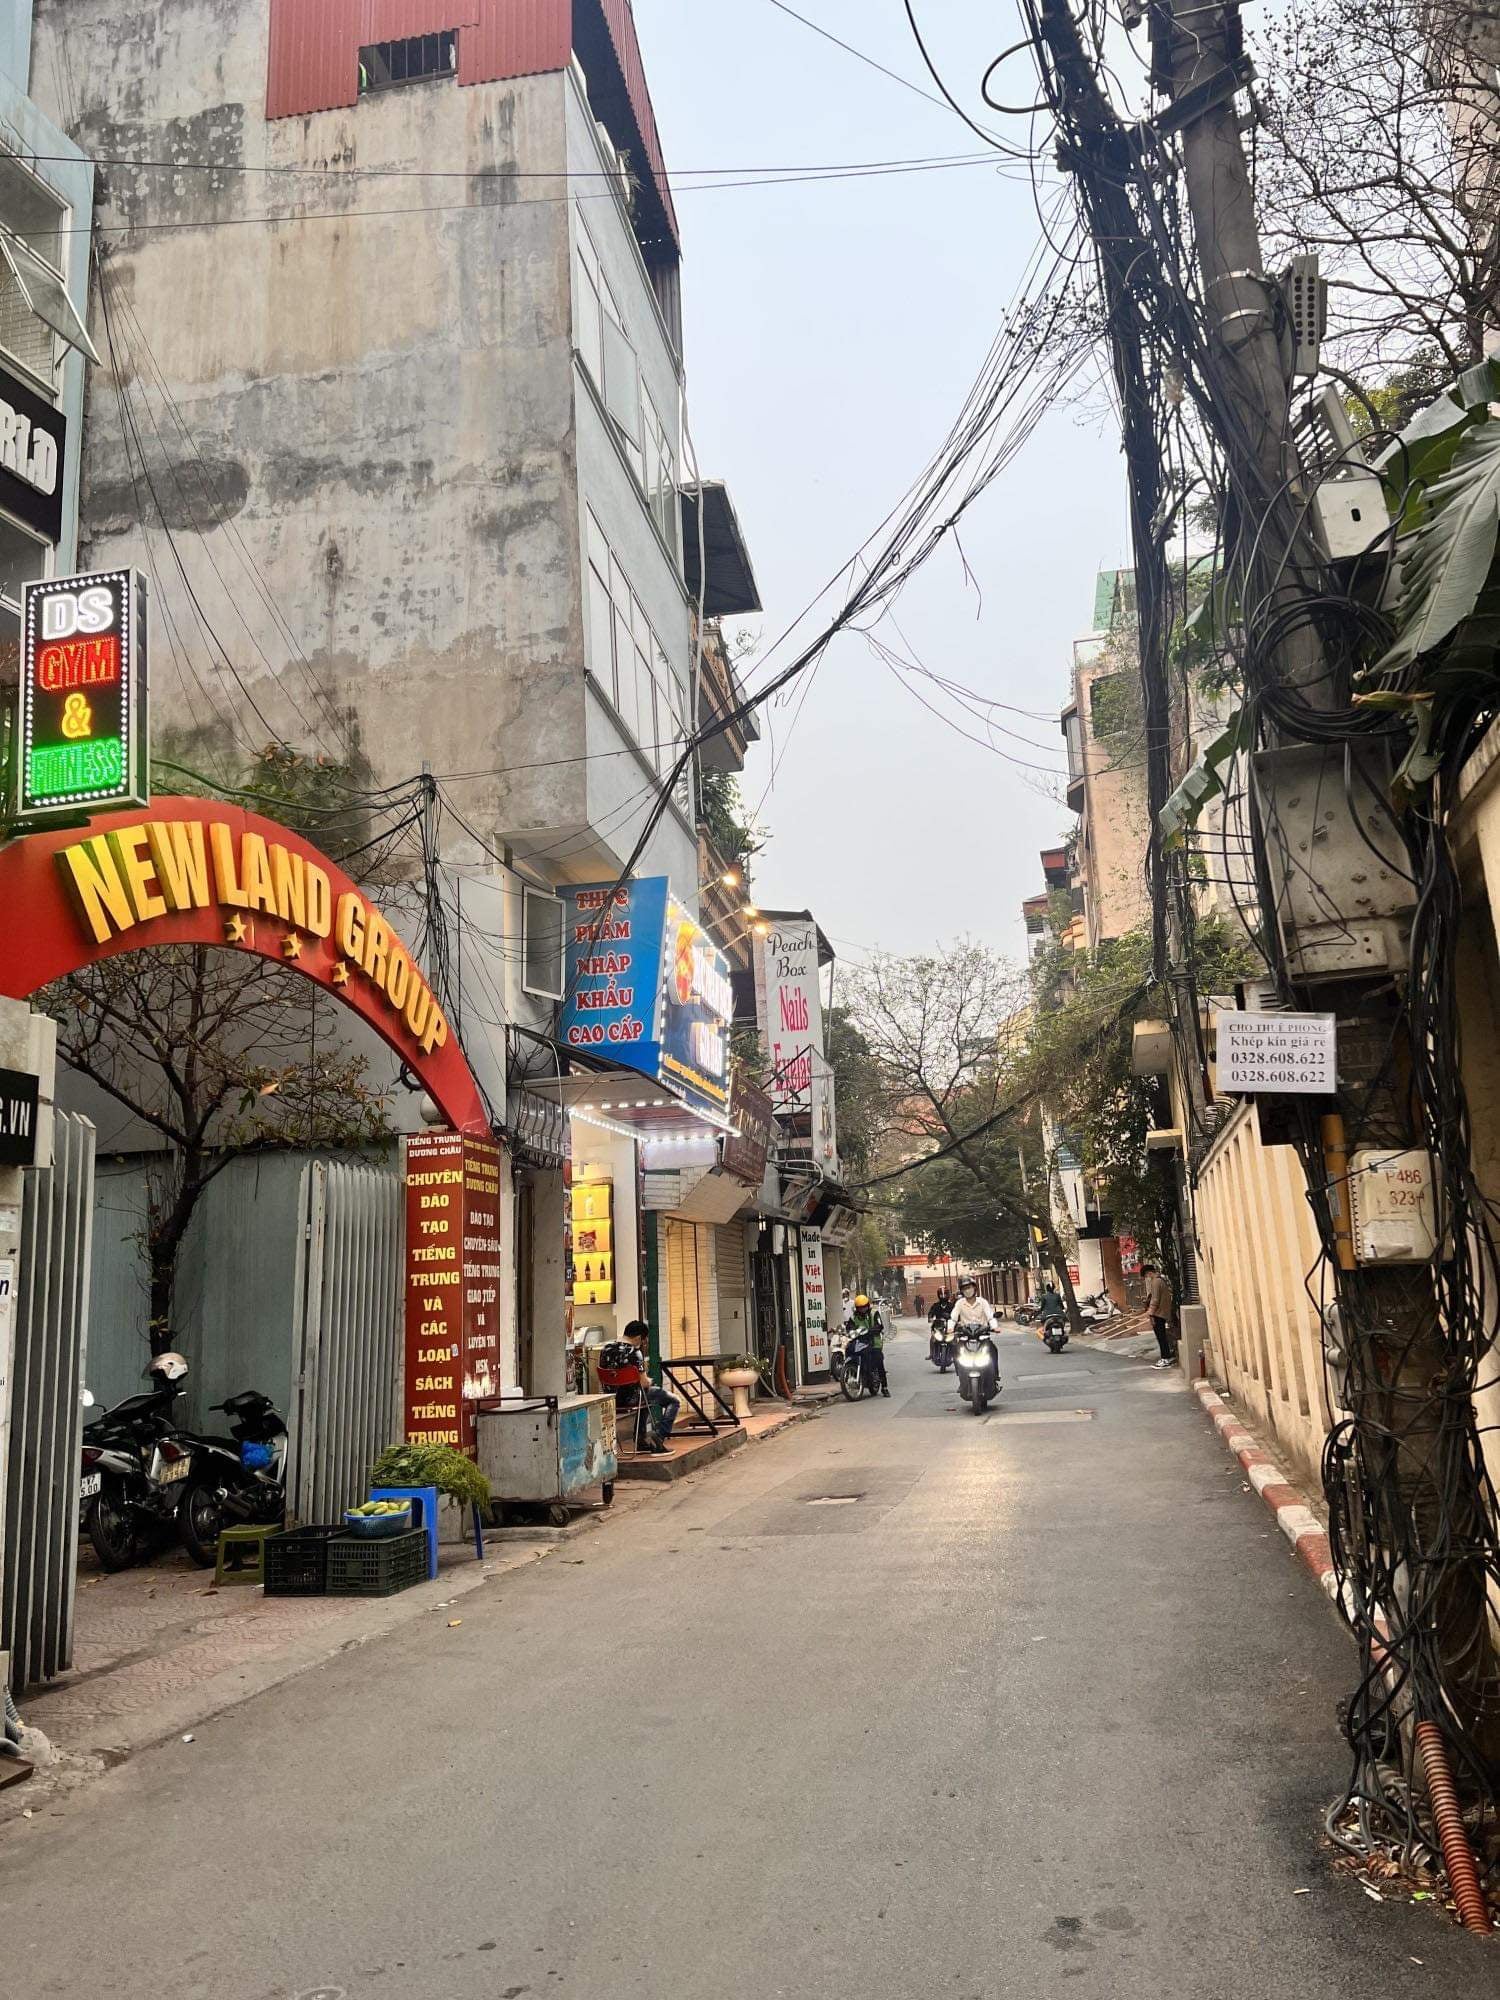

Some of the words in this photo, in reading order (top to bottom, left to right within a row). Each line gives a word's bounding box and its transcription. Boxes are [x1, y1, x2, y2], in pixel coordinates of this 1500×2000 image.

[42, 587, 114, 640] DS
[39, 637, 115, 690] GYM
[62, 693, 91, 738] &
[32, 740, 121, 794] FITNESS
[575, 888, 629, 910] THC
[54, 821, 210, 943] NEW
[210, 822, 331, 938] LAND
[336, 892, 448, 1055] GROUP
[767, 931, 815, 956] Peach
[577, 952, 631, 979] NHẬP
[776, 956, 808, 978] Box
[576, 981, 633, 1010] KHẨU
[779, 985, 809, 1032] Nails
[568, 1025, 604, 1044] CAO
[608, 1014, 643, 1041] CẤP
[1231, 1052, 1326, 1065] 0328.608.622
[1231, 1070, 1326, 1083] 0328.608.622
[433, 1134, 462, 1144] TRUNG
[406, 1169, 463, 1186] CHUYÊN
[421, 1193, 450, 1209] ĐÀO
[421, 1220, 449, 1236] TẠO
[801, 1231, 821, 1243] Made
[412, 1243, 456, 1262] TIẾNG
[807, 1247, 816, 1258] in
[411, 1272, 460, 1287] TRUNG
[805, 1264, 821, 1279] Việt
[805, 1282, 823, 1294] Nam
[423, 1295, 443, 1312] VÀ
[420, 1319, 448, 1336] CÁC
[418, 1348, 451, 1364] LOẠI
[415, 1374, 453, 1391] SÁCH
[412, 1401, 456, 1419] TIẾNG
[408, 1430, 459, 1446] TRUNG
